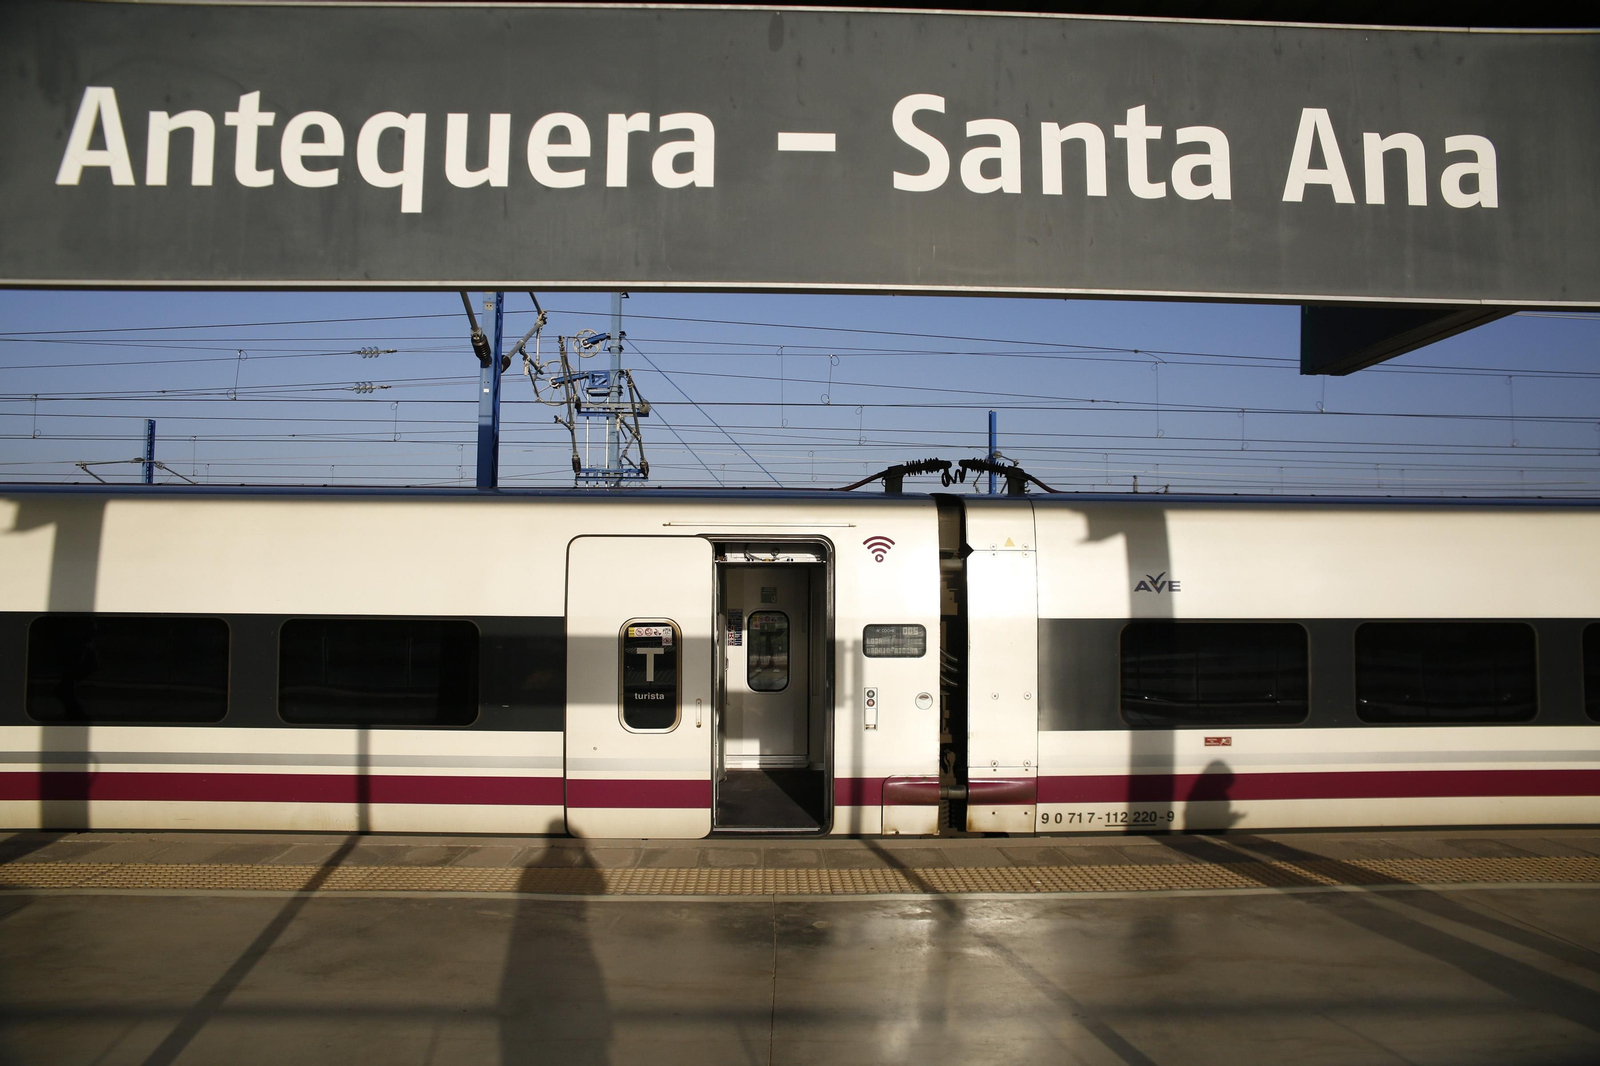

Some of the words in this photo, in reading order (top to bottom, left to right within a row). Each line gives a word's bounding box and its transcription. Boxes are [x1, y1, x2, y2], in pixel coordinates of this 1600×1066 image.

[56, 86, 715, 214] Antequera
[892, 93, 1232, 201] Santa
[1282, 107, 1499, 209] Ana
[1133, 571, 1182, 594] AVE
[636, 647, 665, 682] T
[634, 692, 665, 700] turista
